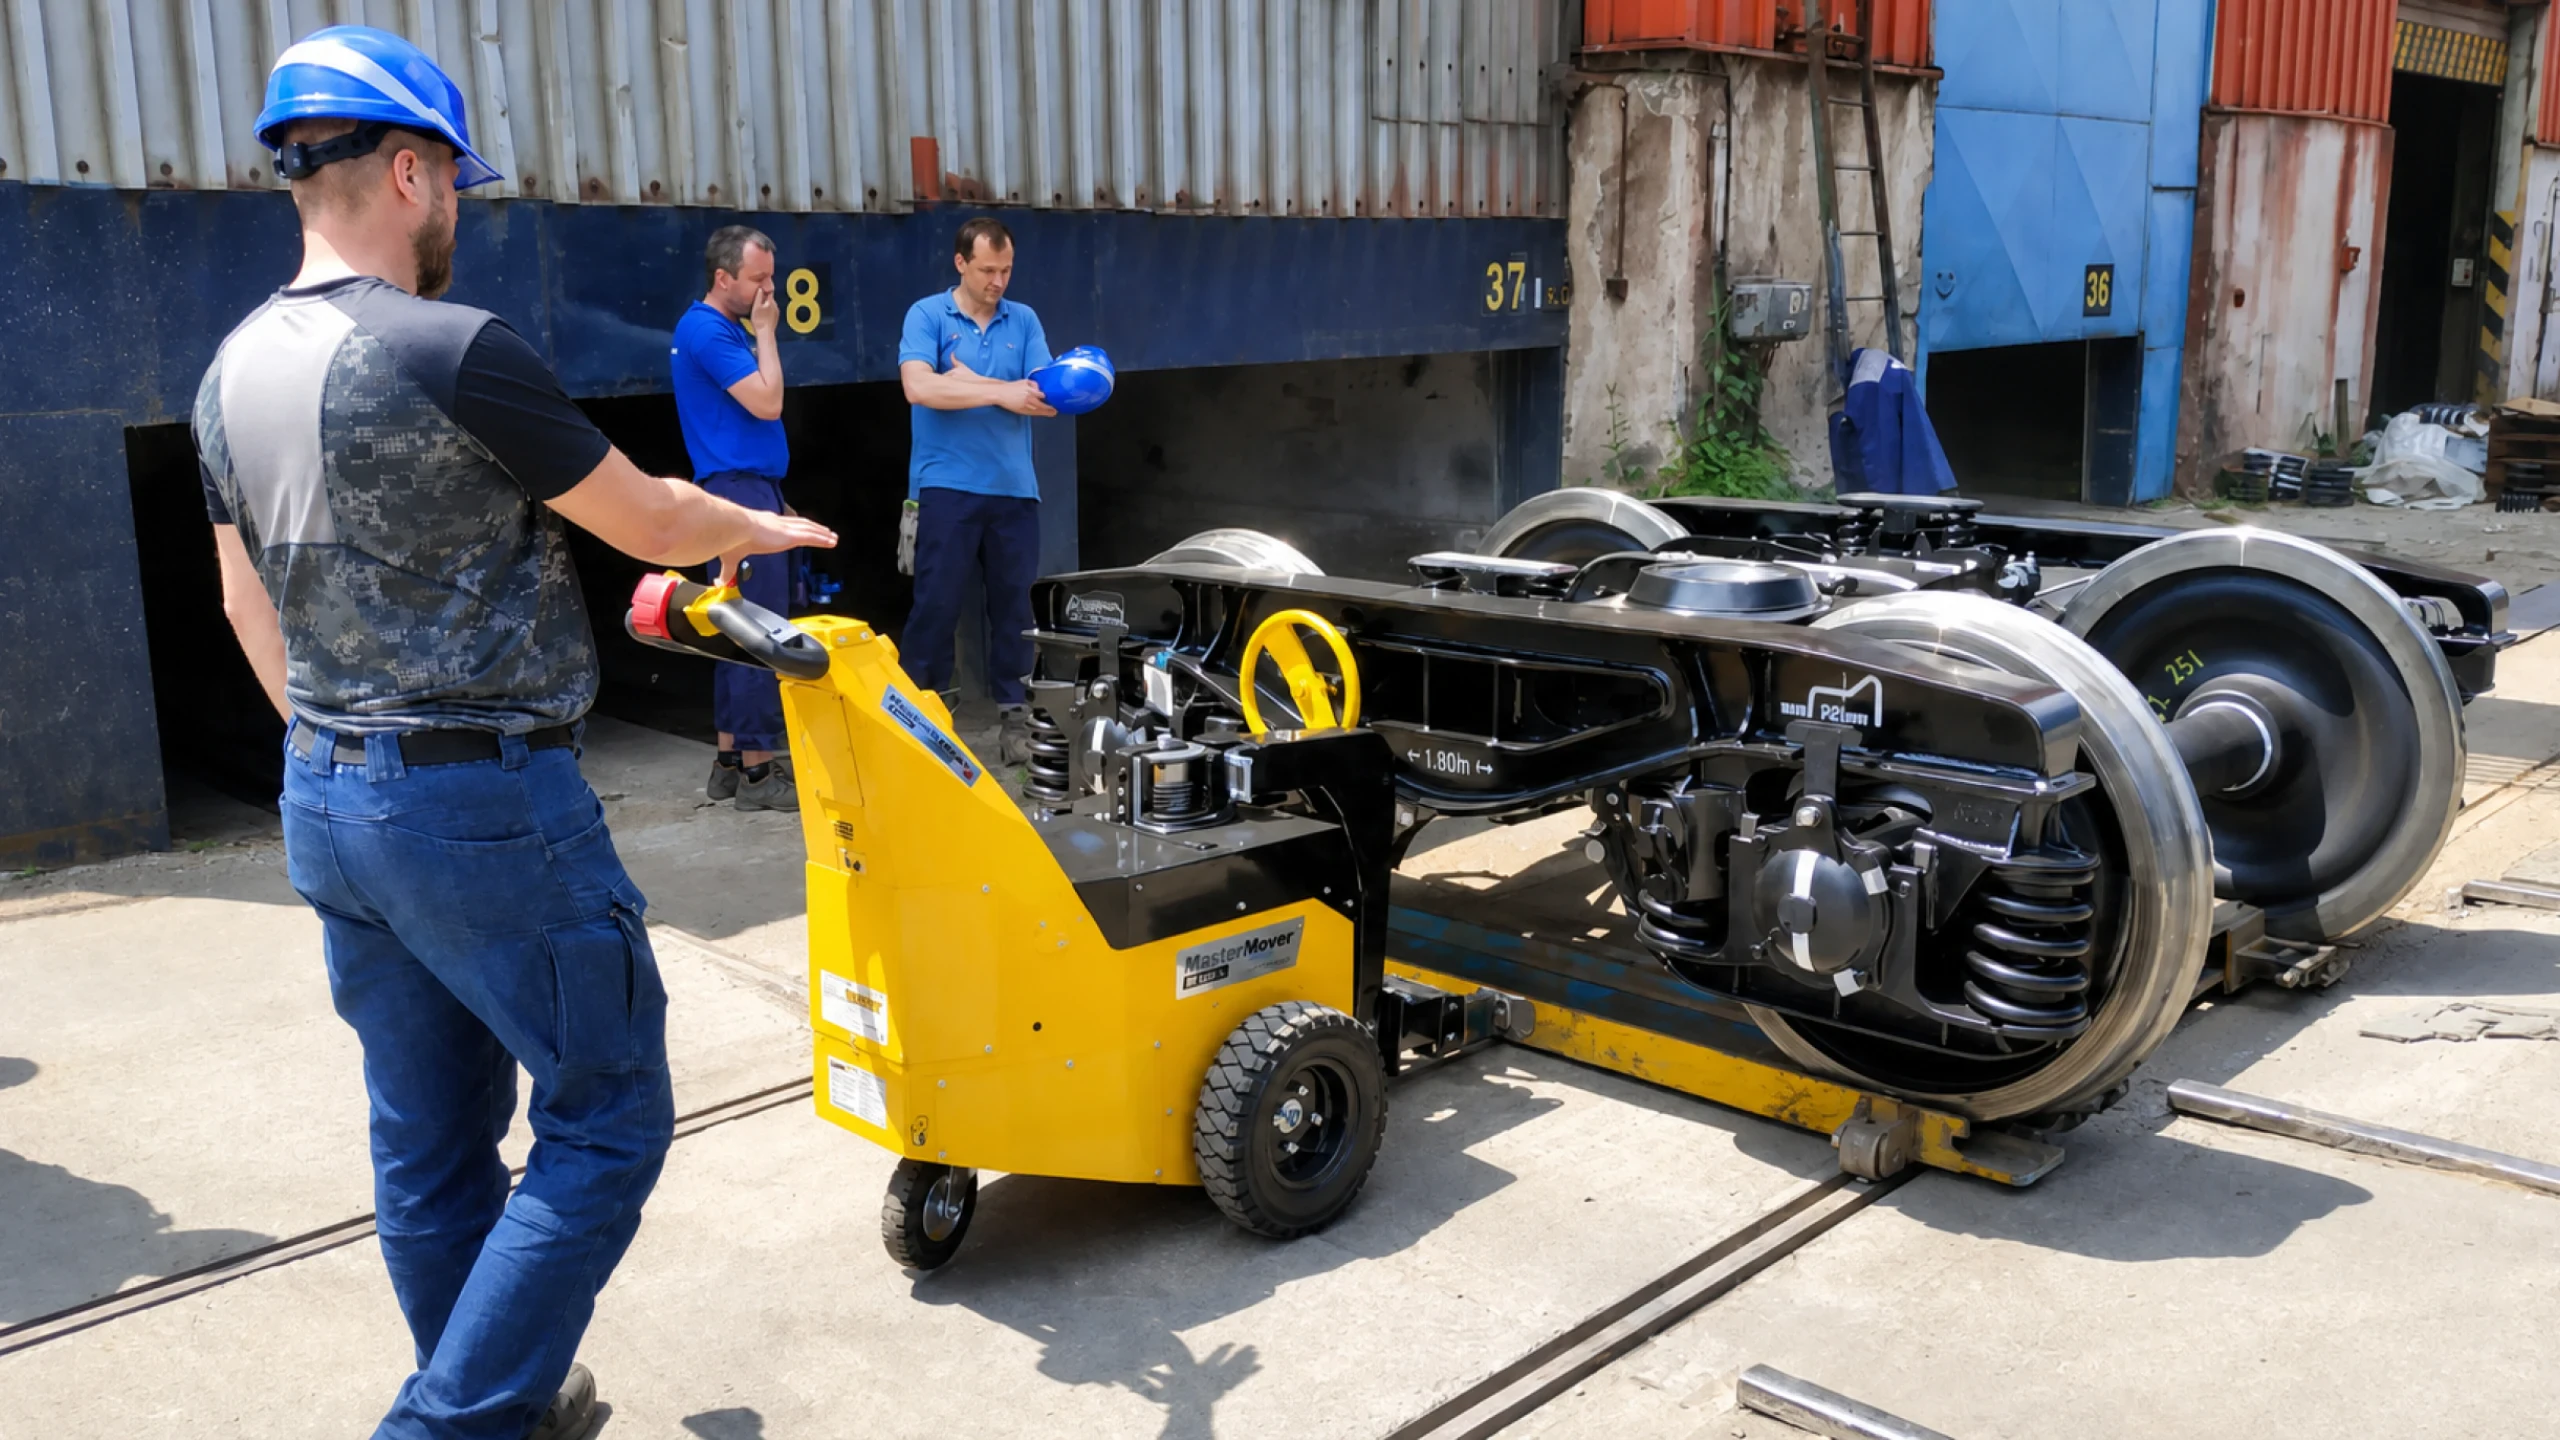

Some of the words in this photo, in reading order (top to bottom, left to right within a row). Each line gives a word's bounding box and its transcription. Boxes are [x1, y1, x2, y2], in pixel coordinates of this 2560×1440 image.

[1486, 262, 1525, 311] 37
[2087, 271, 2109, 307] 36
[2165, 649, 2204, 685] 251
[1425, 748, 1471, 775] 1.80m
[1184, 931, 1295, 973] MasterMover
